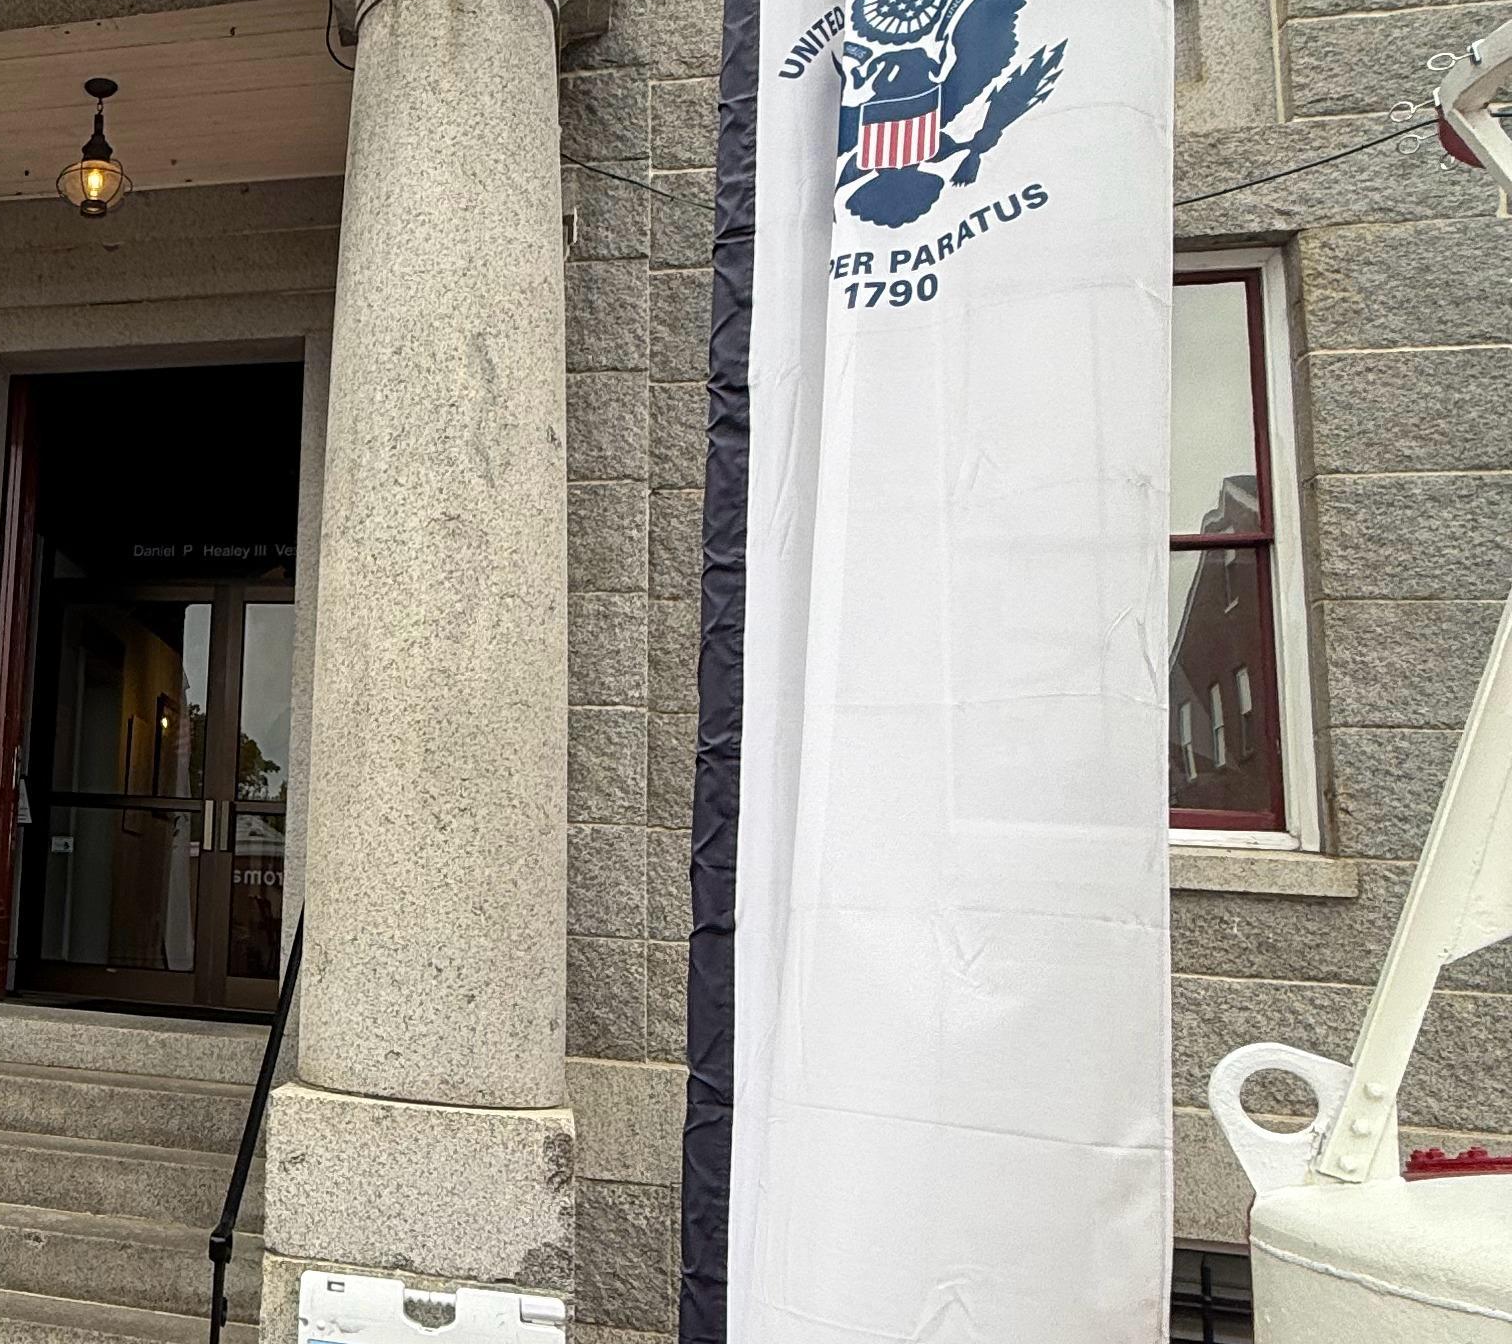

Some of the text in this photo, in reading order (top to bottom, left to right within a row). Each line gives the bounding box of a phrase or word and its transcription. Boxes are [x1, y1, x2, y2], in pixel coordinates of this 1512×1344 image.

[778, 6, 845, 80] UNITED
[889, 183, 1050, 274] PARATUS
[844, 273, 939, 309] 1790
[133, 544, 176, 558] Daniel
[203, 544, 249, 560] Healey
